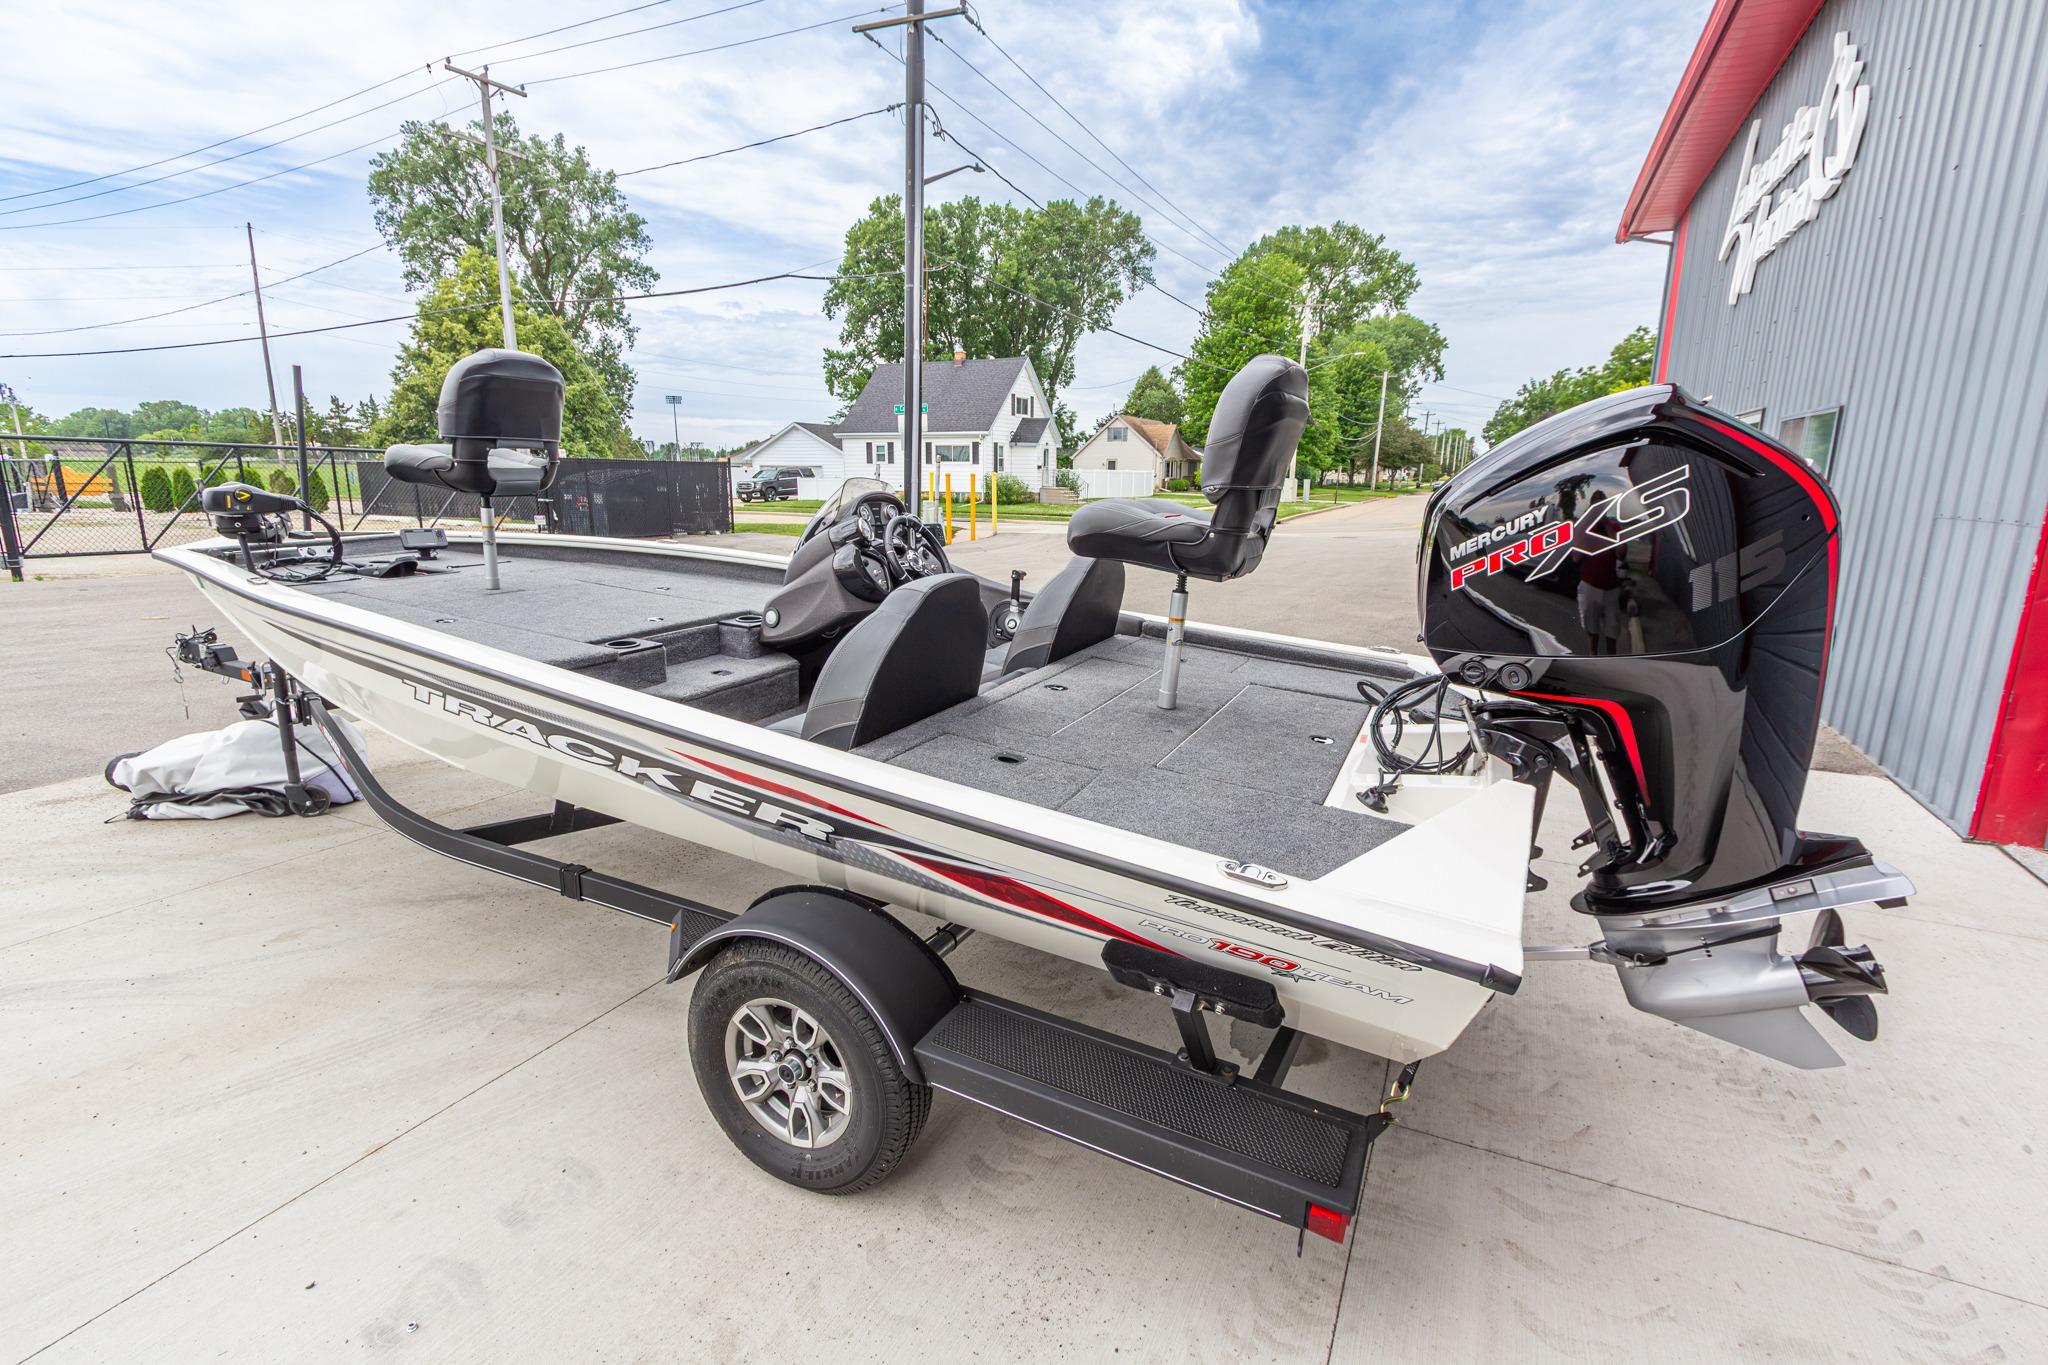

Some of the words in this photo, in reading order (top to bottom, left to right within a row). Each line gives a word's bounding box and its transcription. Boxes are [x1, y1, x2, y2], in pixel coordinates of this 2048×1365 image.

[1718, 105, 1822, 262] Lakeside
[1450, 504, 1549, 562] MERCURY
[1689, 528, 1787, 613] 115
[400, 677, 838, 846] TRACKER
[1138, 919, 1209, 945] PRO
[1209, 937, 1301, 974] 190
[1300, 966, 1414, 1006] TEAM
[1163, 894, 1318, 941] Tournament
[1311, 938, 1423, 972] Edition
